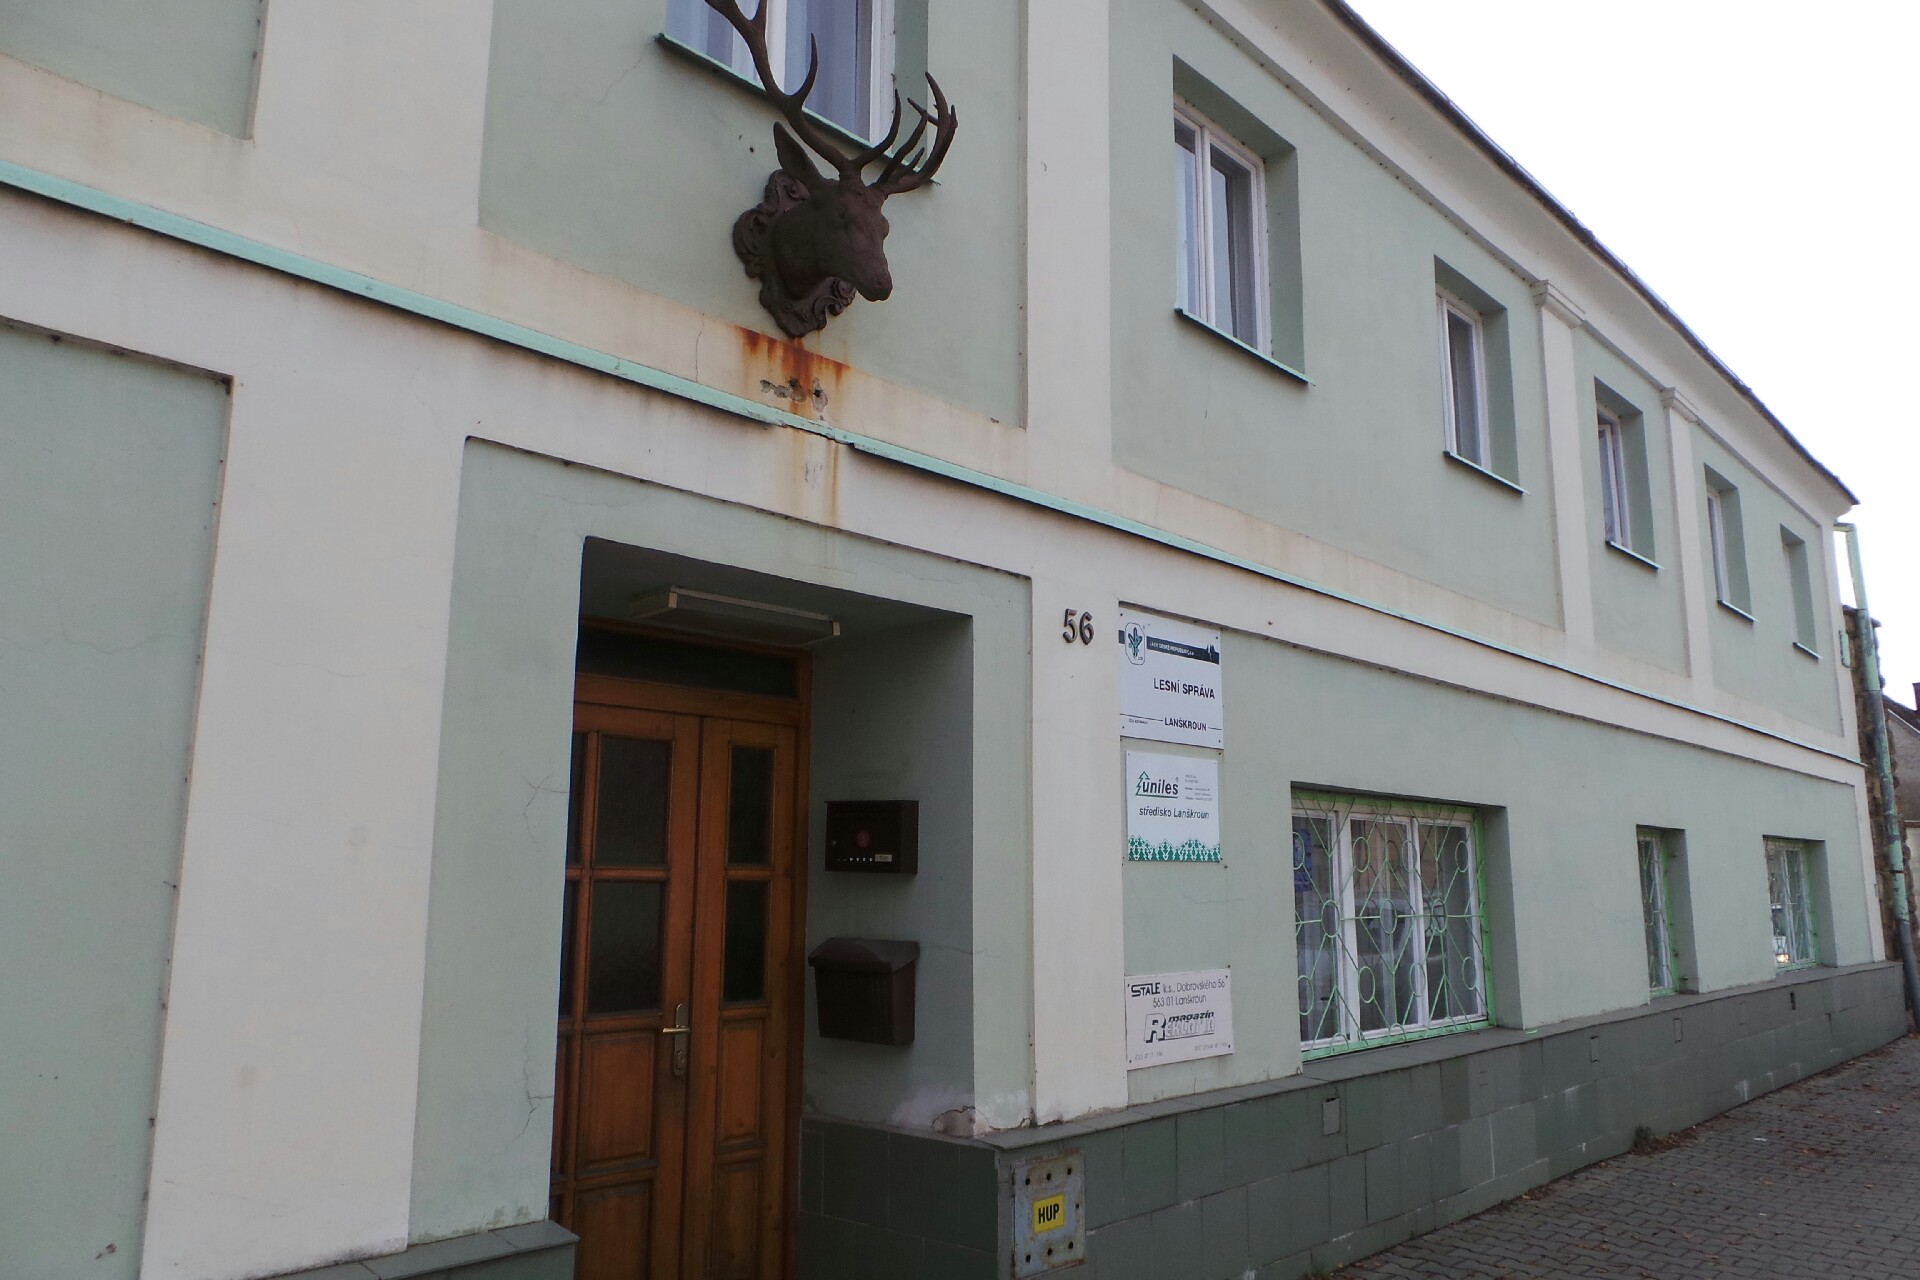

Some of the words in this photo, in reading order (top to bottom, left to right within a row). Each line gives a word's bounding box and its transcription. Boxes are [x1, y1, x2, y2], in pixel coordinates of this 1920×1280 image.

[1062, 608, 1095, 646] 56
[1153, 677, 1180, 694] LESNÍ
[1182, 684, 1215, 700] SPRÁVA
[1164, 717, 1207, 732] LANŠKROUN
[1142, 779, 1178, 795] uniles
[1139, 805, 1172, 817] středisko
[1173, 808, 1209, 819] Lanškroun
[1131, 982, 1160, 998] STALE
[1176, 980, 1217, 993] Dobrovského
[1217, 979, 1225, 988] 56
[1153, 997, 1164, 1008] 563
[1166, 996, 1173, 1006] 01
[1175, 995, 1206, 1005] Lanškroun
[1168, 1010, 1215, 1023] magazín
[1038, 1203, 1060, 1224] HUP
